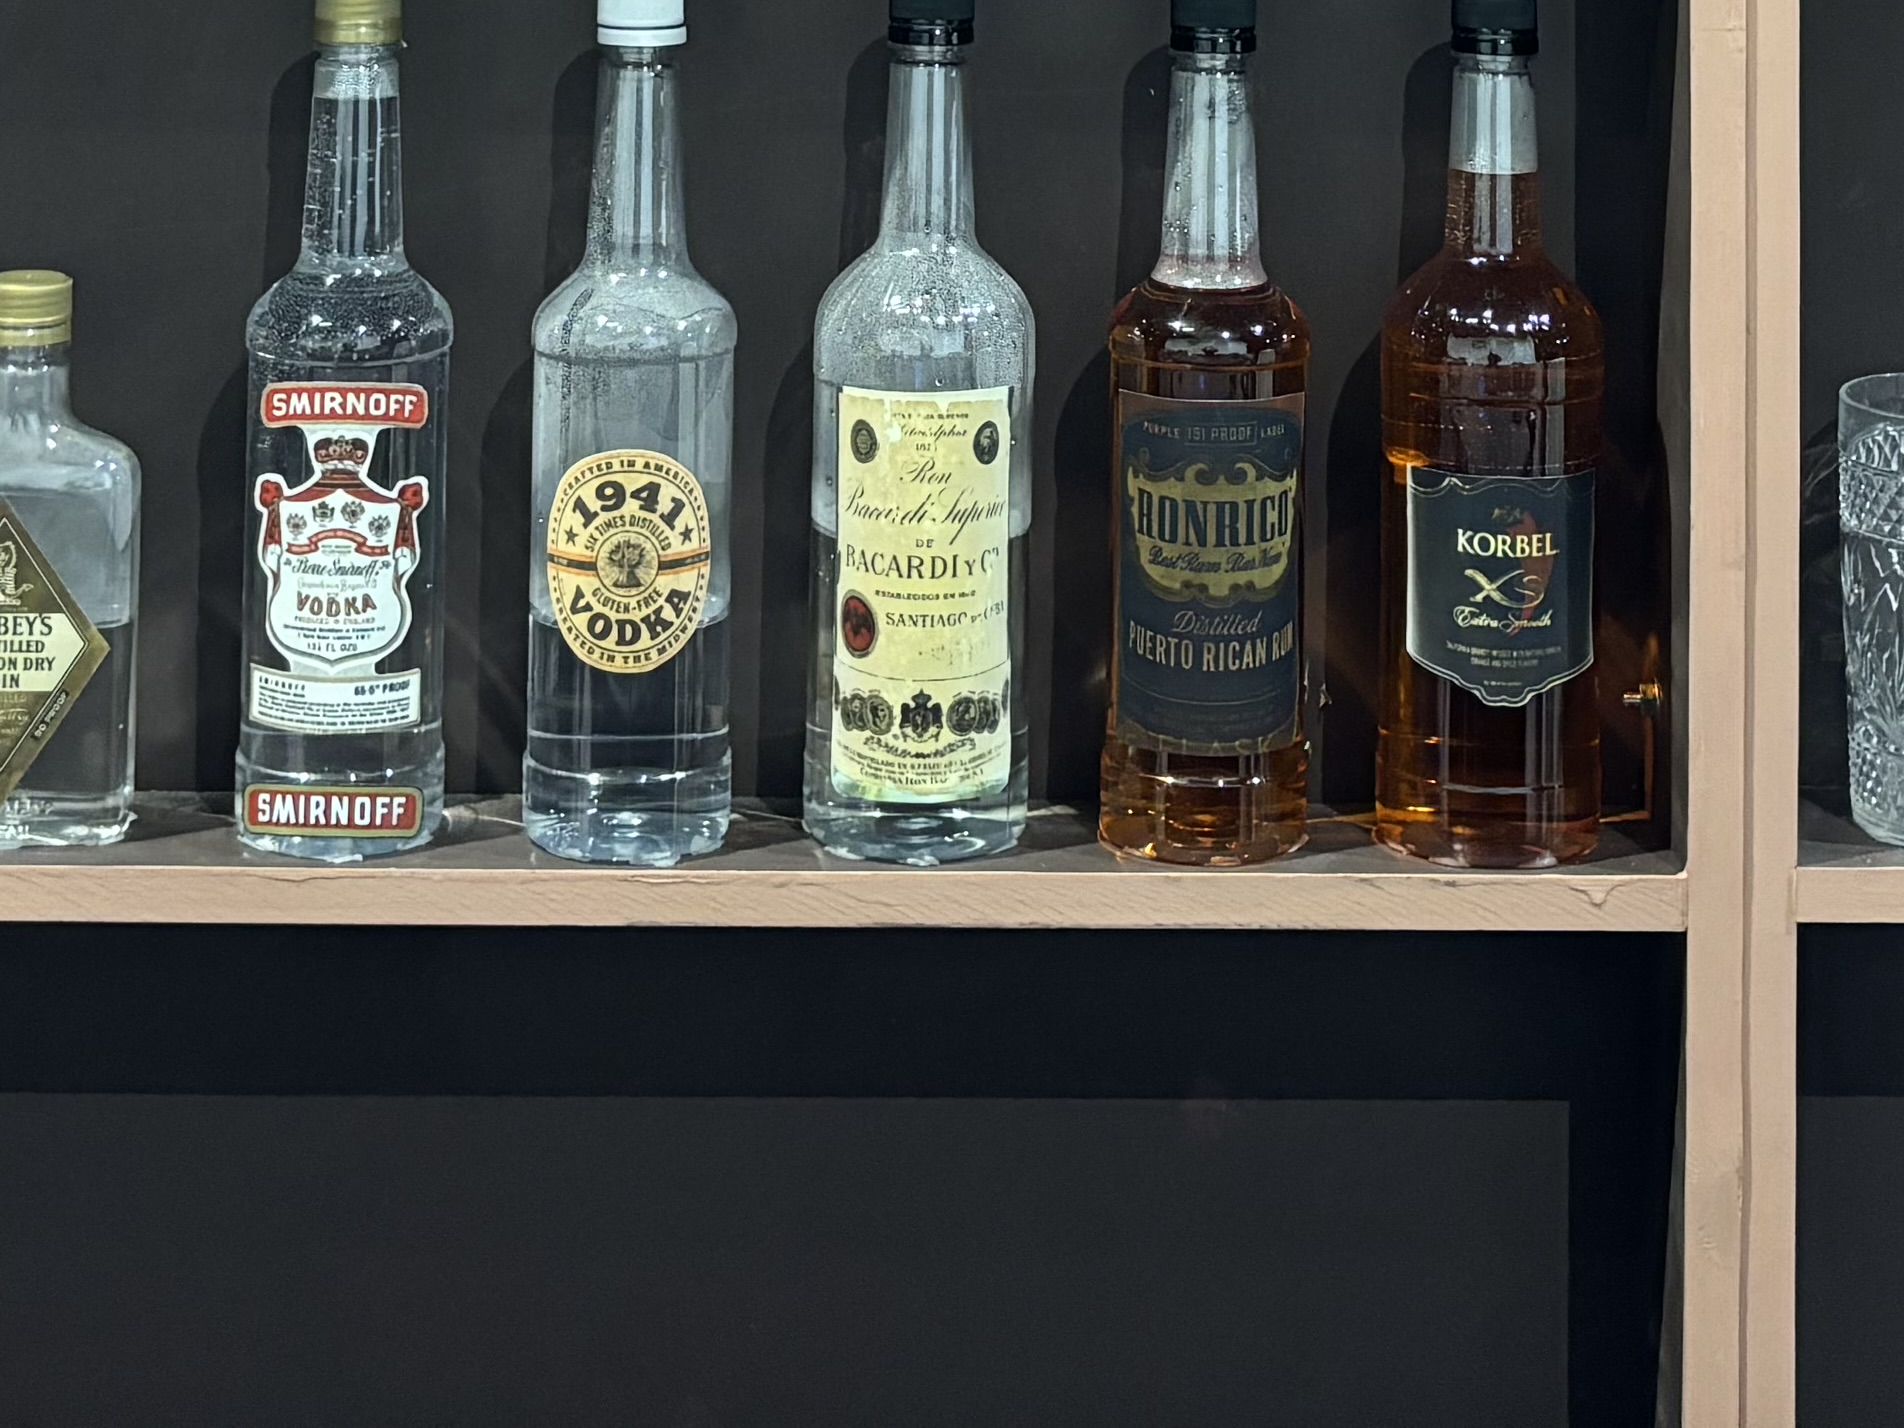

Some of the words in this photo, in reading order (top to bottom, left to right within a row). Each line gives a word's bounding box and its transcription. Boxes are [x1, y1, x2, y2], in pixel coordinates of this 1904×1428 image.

[271, 391, 418, 418] SMIRNOFF
[562, 460, 613, 496] CRAFTED
[620, 459, 636, 469] IN
[642, 460, 695, 496] AMERICA
[572, 480, 686, 531] 1941
[1136, 486, 1290, 549] RONRICO
[585, 532, 598, 552] SIX
[596, 514, 626, 540] TIMES
[629, 514, 672, 552] DISTILLED
[915, 538, 934, 549] DE
[1456, 528, 1560, 558] KORBEL
[845, 543, 961, 580] BACARDI
[295, 590, 378, 616] VODKA
[592, 587, 664, 615] GLUTEN-FREE
[1464, 568, 1545, 609] XS
[569, 585, 692, 646] VODKA
[1172, 609, 1263, 636] Distilled
[622, 653, 653, 665] THE
[1129, 620, 1193, 670] PUERTO
[1202, 635, 1268, 672] RICAN
[23, 656, 56, 671] DRY
[257, 792, 408, 826] SMIRNOFF
